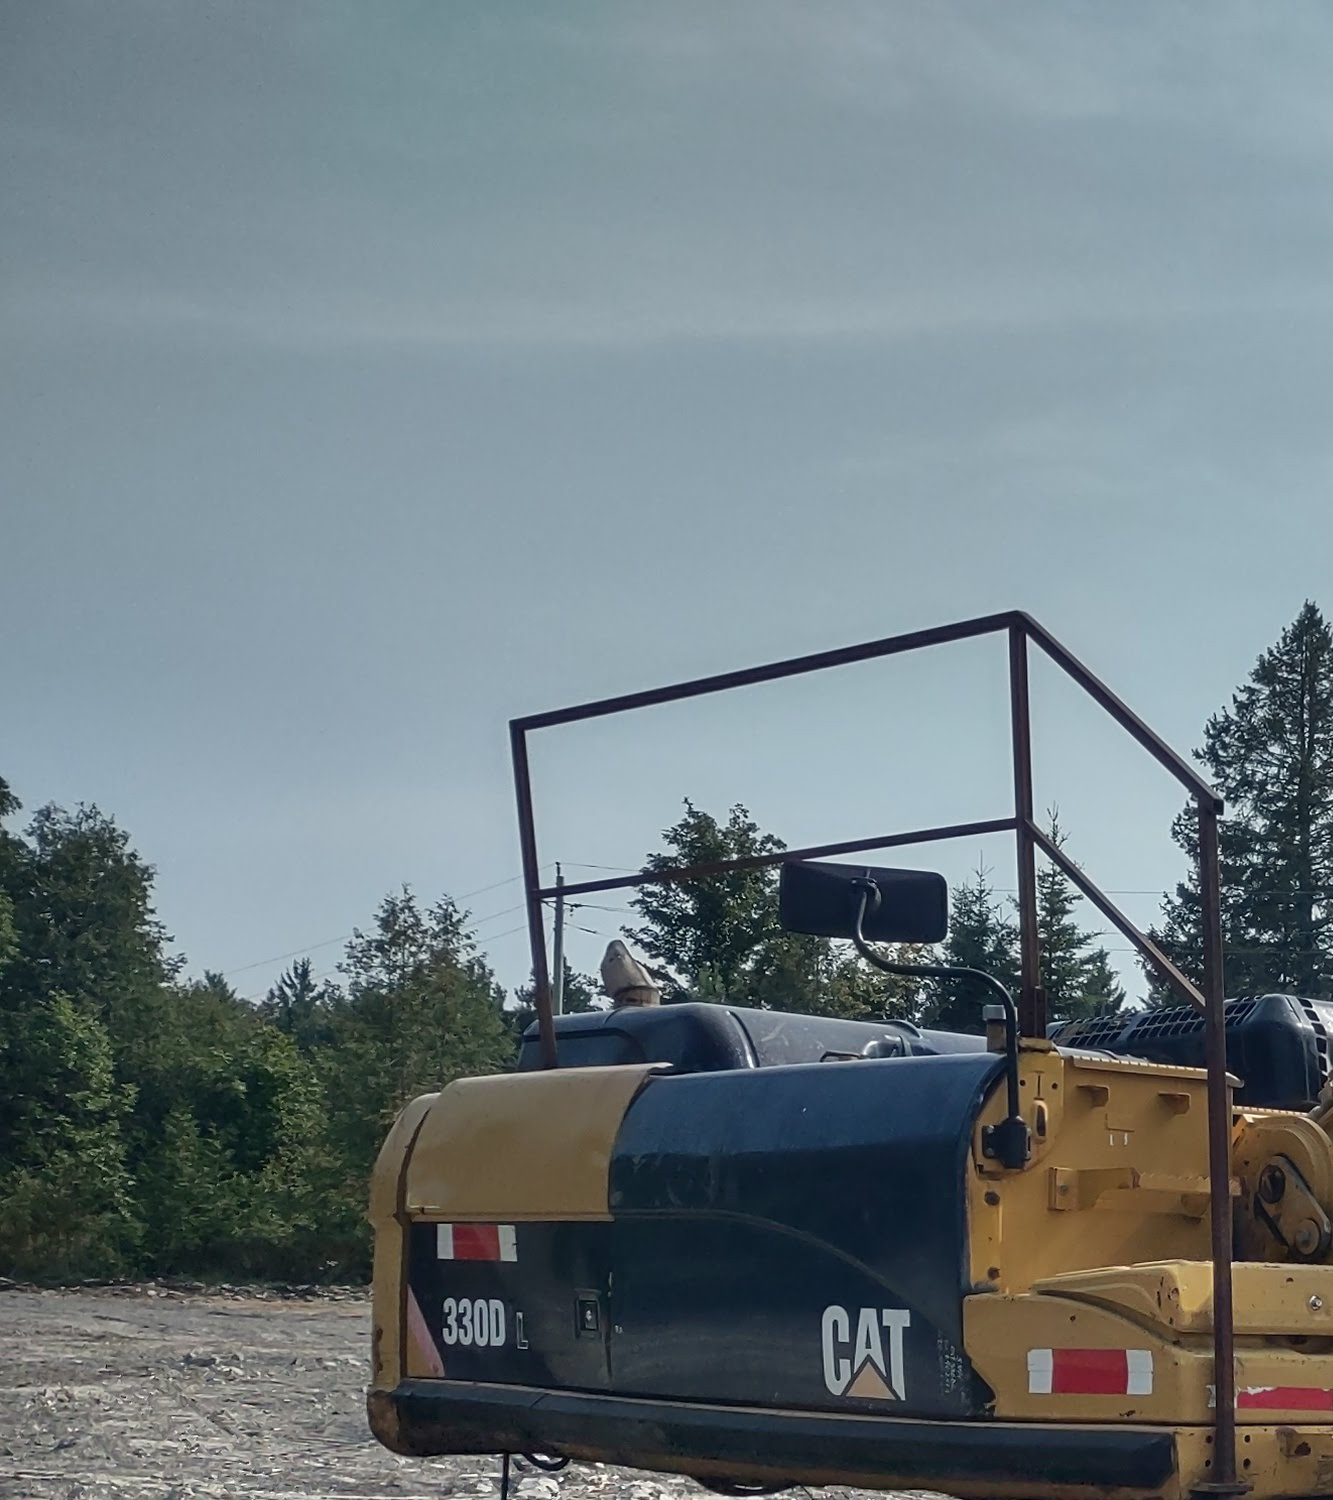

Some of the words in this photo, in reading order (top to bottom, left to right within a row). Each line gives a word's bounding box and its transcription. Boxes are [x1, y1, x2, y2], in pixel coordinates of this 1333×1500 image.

[442, 1297, 506, 1347] 330D
[516, 1312, 529, 1350] L
[821, 1305, 911, 1401] CAT
